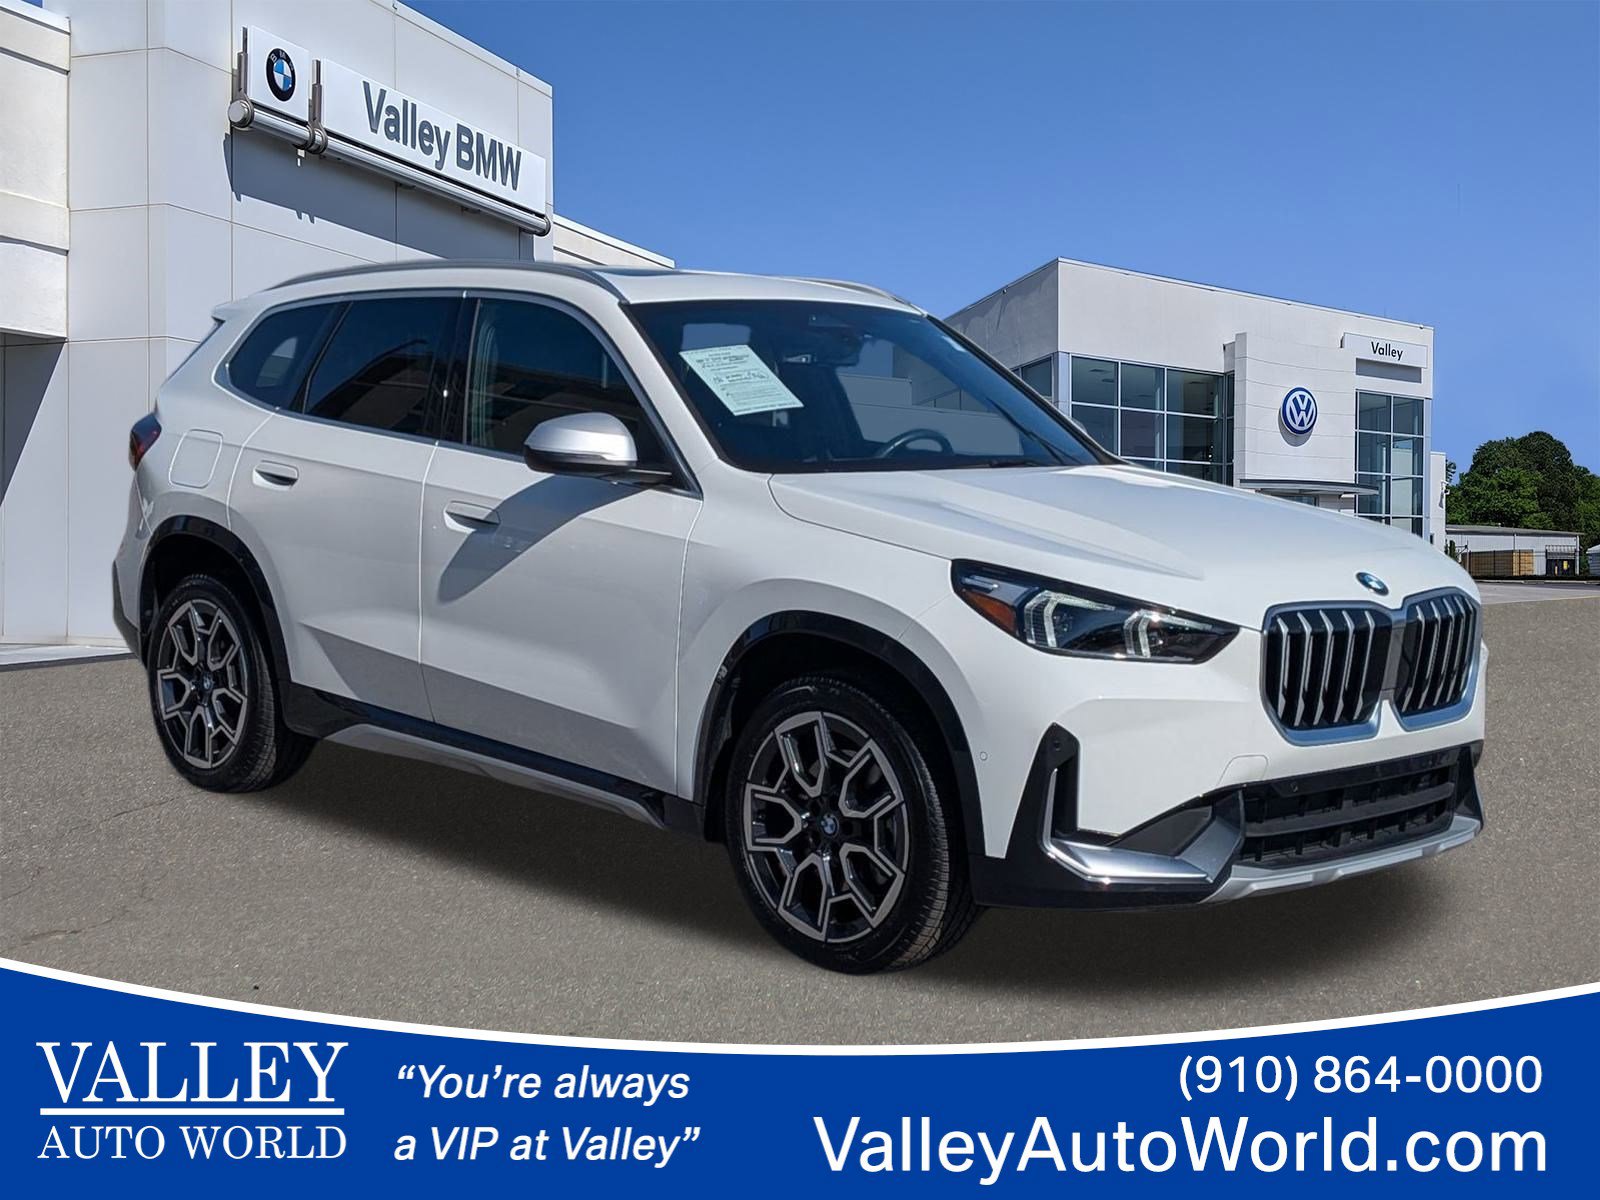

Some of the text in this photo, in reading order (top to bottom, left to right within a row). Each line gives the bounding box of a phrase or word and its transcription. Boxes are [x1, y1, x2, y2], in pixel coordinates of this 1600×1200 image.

[362, 80, 523, 192] Valley BMW
[1371, 341, 1403, 361] Valley
